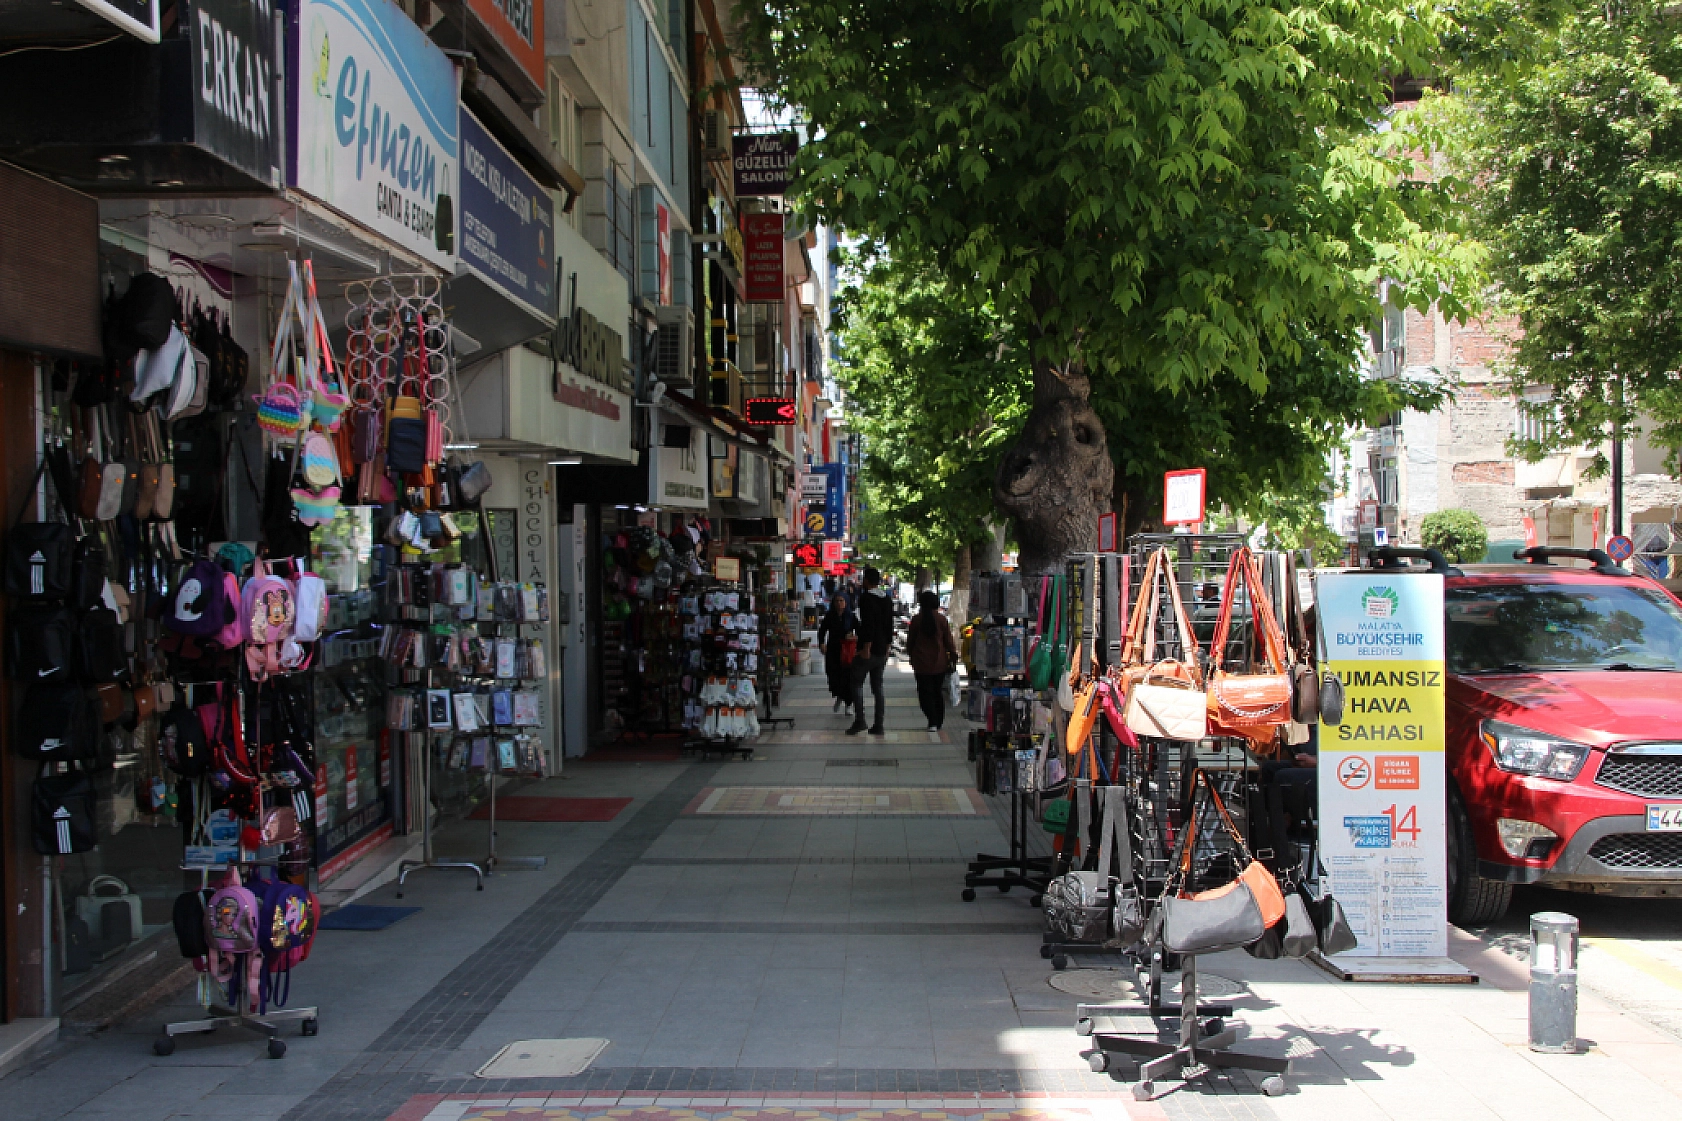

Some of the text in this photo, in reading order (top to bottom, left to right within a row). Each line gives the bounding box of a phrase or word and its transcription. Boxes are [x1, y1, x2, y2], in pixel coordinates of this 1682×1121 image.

[198, 8, 271, 139] ERKAN
[335, 55, 435, 204] Efruzen
[464, 139, 488, 188] NOBEL
[378, 181, 402, 224] ÇANTA
[412, 203, 434, 240] EŞARP
[1358, 622, 1403, 630] MALATYA
[1336, 633, 1423, 646] BÜYÜKŞEHİR
[1351, 697, 1412, 713] HAVA
[1338, 725, 1423, 741] SAHASI
[1381, 803, 1422, 840] 14
[1392, 841, 1418, 849] KURAL
